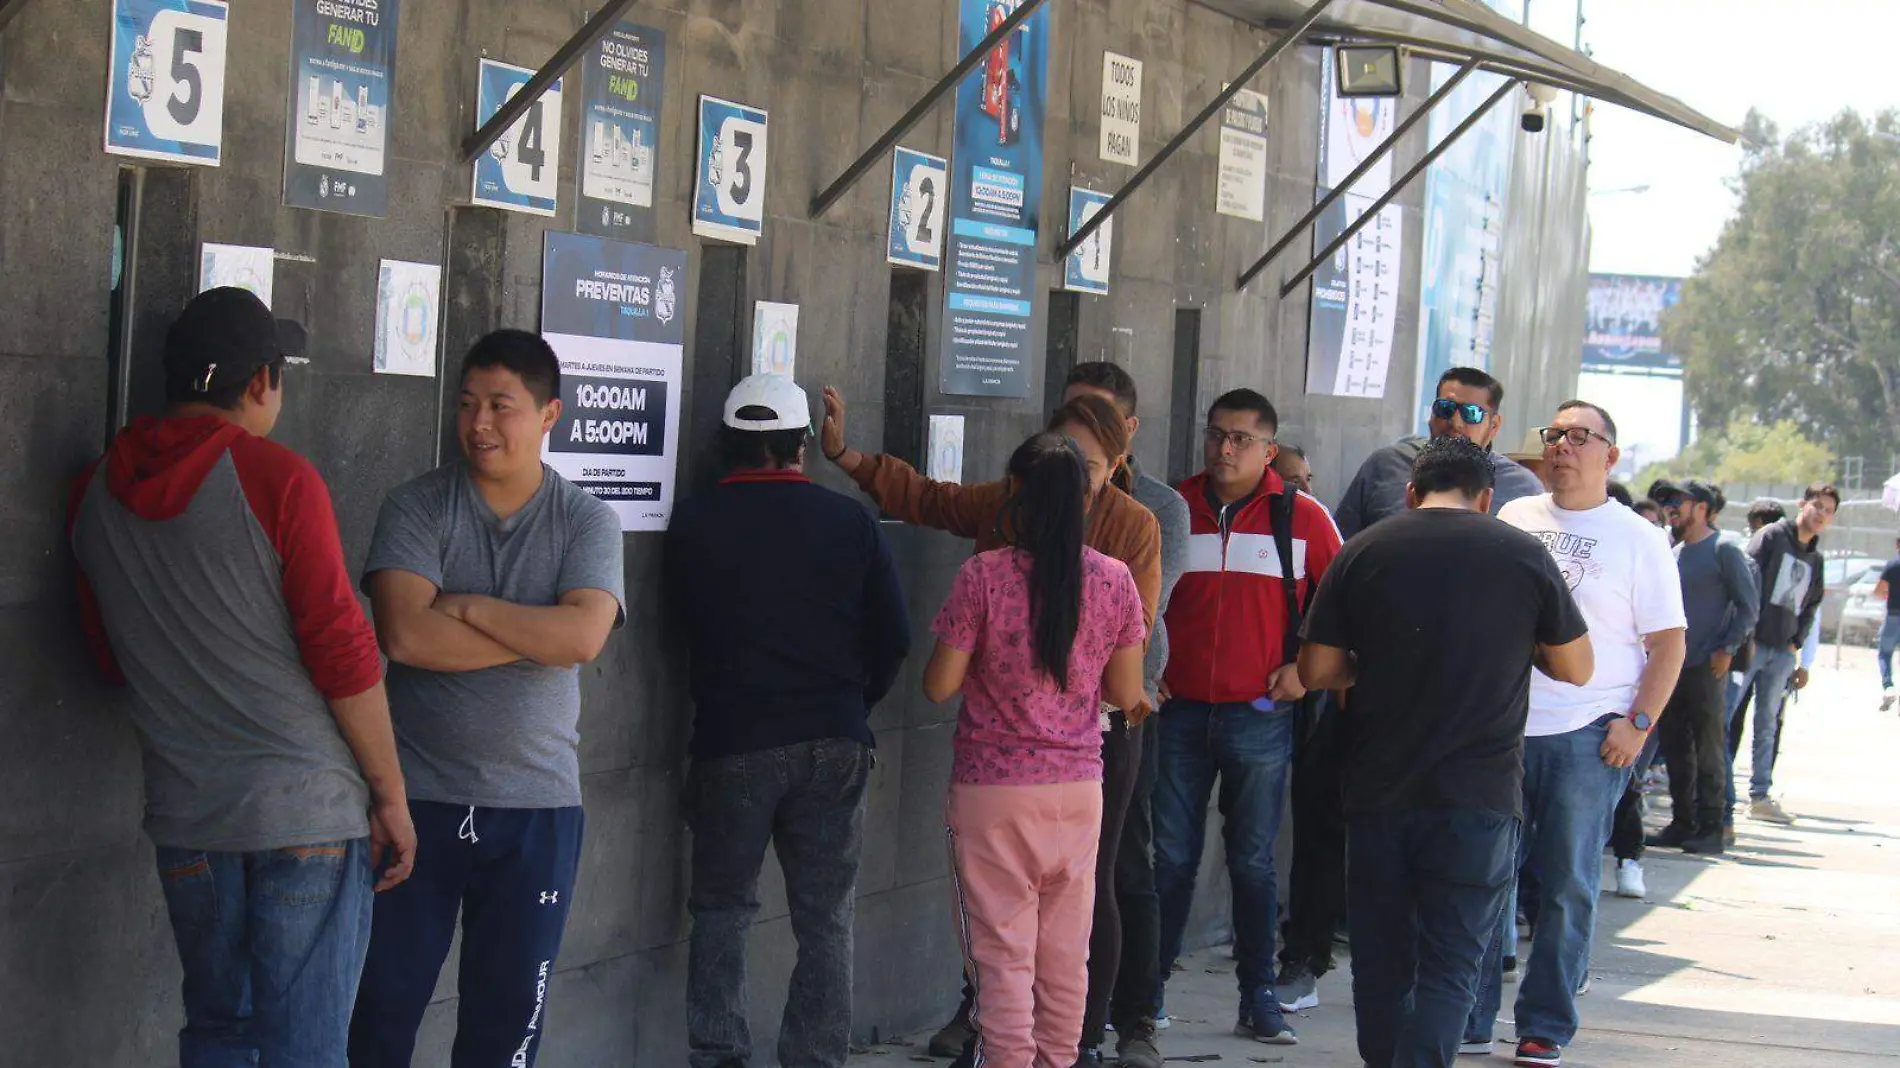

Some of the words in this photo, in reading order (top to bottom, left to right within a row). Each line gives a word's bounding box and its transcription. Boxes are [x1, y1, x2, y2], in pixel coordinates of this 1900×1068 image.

[316, 0, 364, 23] GENERAR
[366, 11, 379, 26] TU
[603, 40, 615, 55] NO
[616, 43, 648, 63] OLVIDES
[167, 27, 203, 126] 5
[600, 54, 637, 75] GENERAR
[638, 63, 649, 77] TU
[1112, 61, 1134, 86] TODOS
[1102, 95, 1115, 118] LOS
[517, 101, 545, 182] 4
[729, 130, 753, 204] 3
[916, 177, 935, 243] 2
[576, 278, 649, 305] PREVENTAS
[643, 368, 665, 376] PARTIDO
[576, 384, 647, 411] 10:00AM
[570, 418, 583, 443] A
[585, 419, 649, 445] 5:00PM
[593, 469, 600, 477] DE
[601, 469, 626, 478] PARTIDO
[634, 487, 654, 496] TIEMPO
